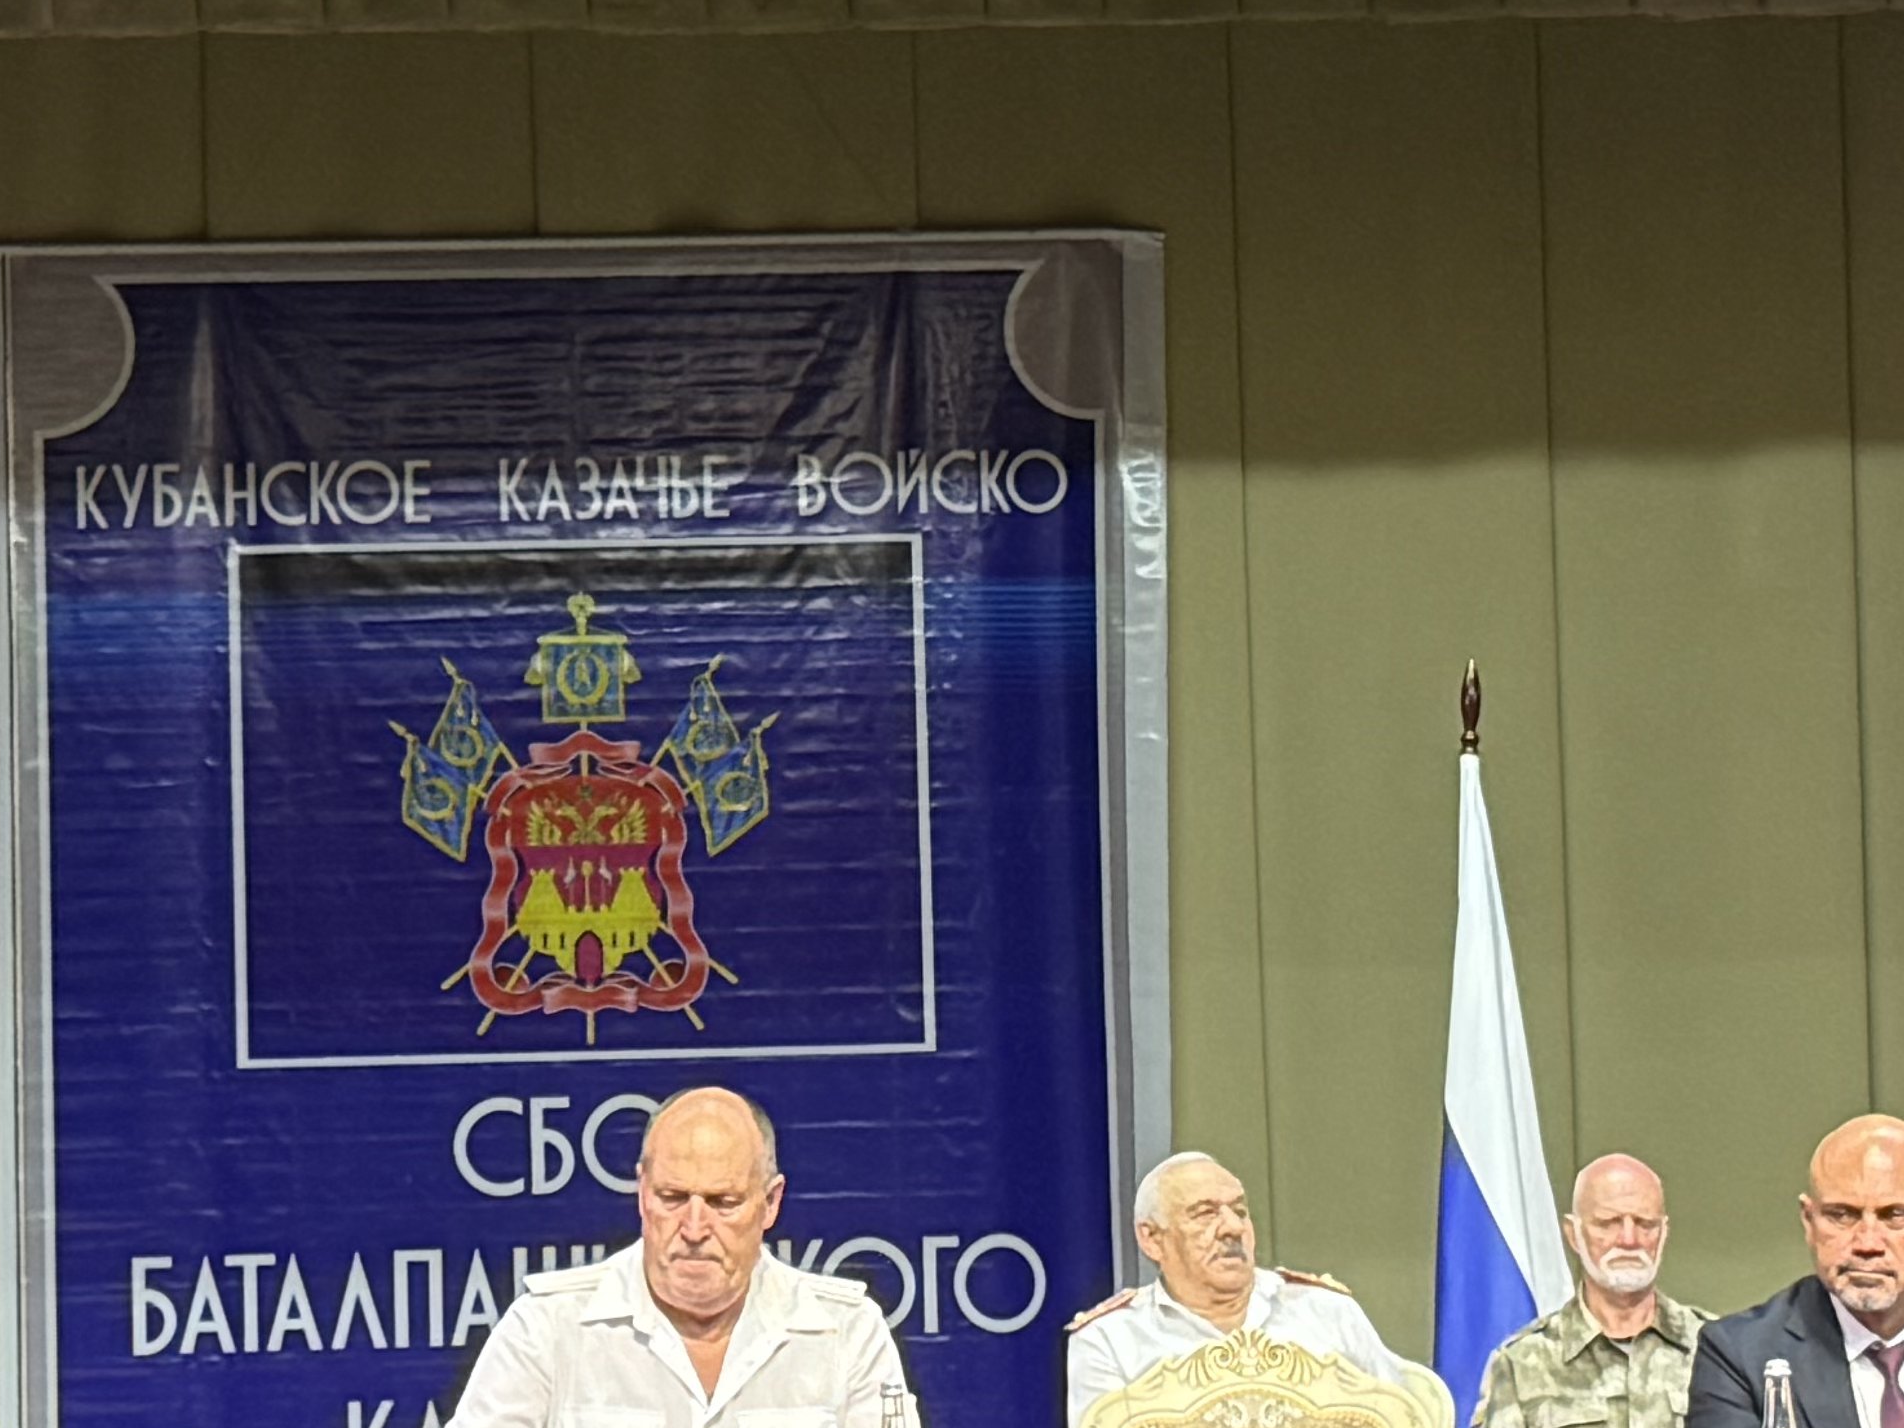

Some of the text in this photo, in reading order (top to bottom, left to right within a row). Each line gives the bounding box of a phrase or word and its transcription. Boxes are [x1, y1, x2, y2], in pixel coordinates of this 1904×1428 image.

[76, 448, 1068, 530] КУБАНСКОЕ КАЗАЧЬЕ ВОЙСКО
[453, 1093, 662, 1197] СБО
